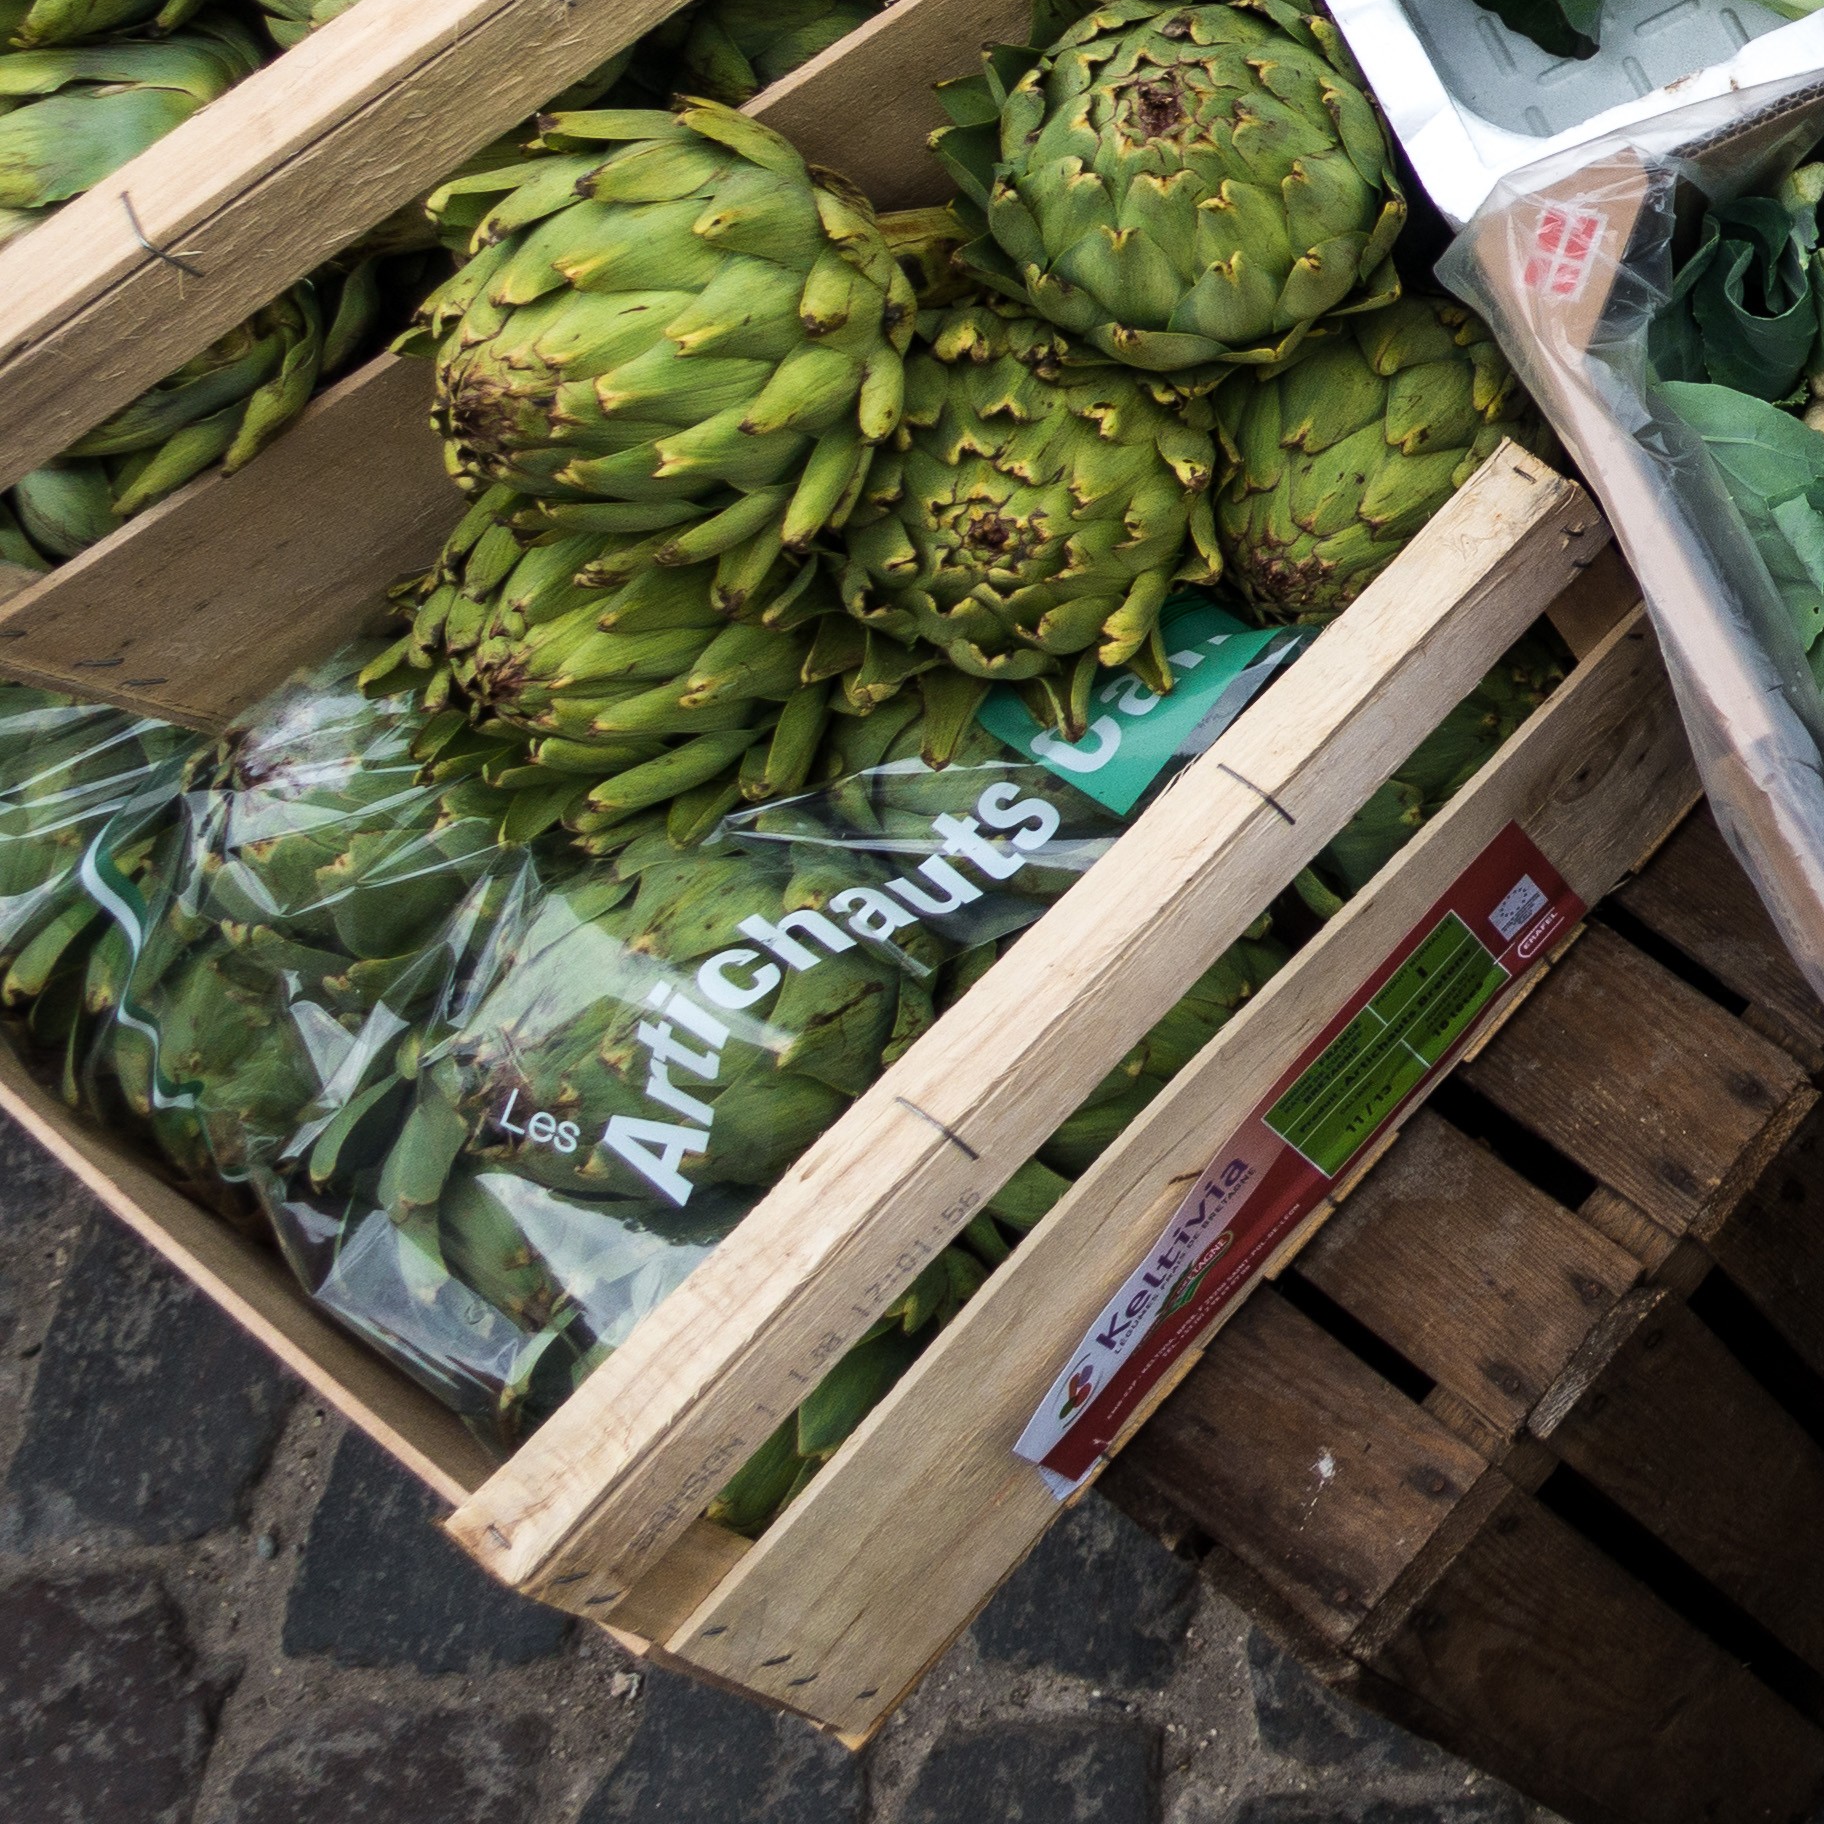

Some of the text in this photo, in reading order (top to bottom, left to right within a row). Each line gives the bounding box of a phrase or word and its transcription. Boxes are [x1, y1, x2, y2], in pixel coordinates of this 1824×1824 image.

[602, 779, 1062, 1208] Artichauts
[501, 1088, 582, 1155] Les
[1096, 1153, 1250, 1352] Keltivia
[1201, 1167, 1256, 1229] BRETAGNE
